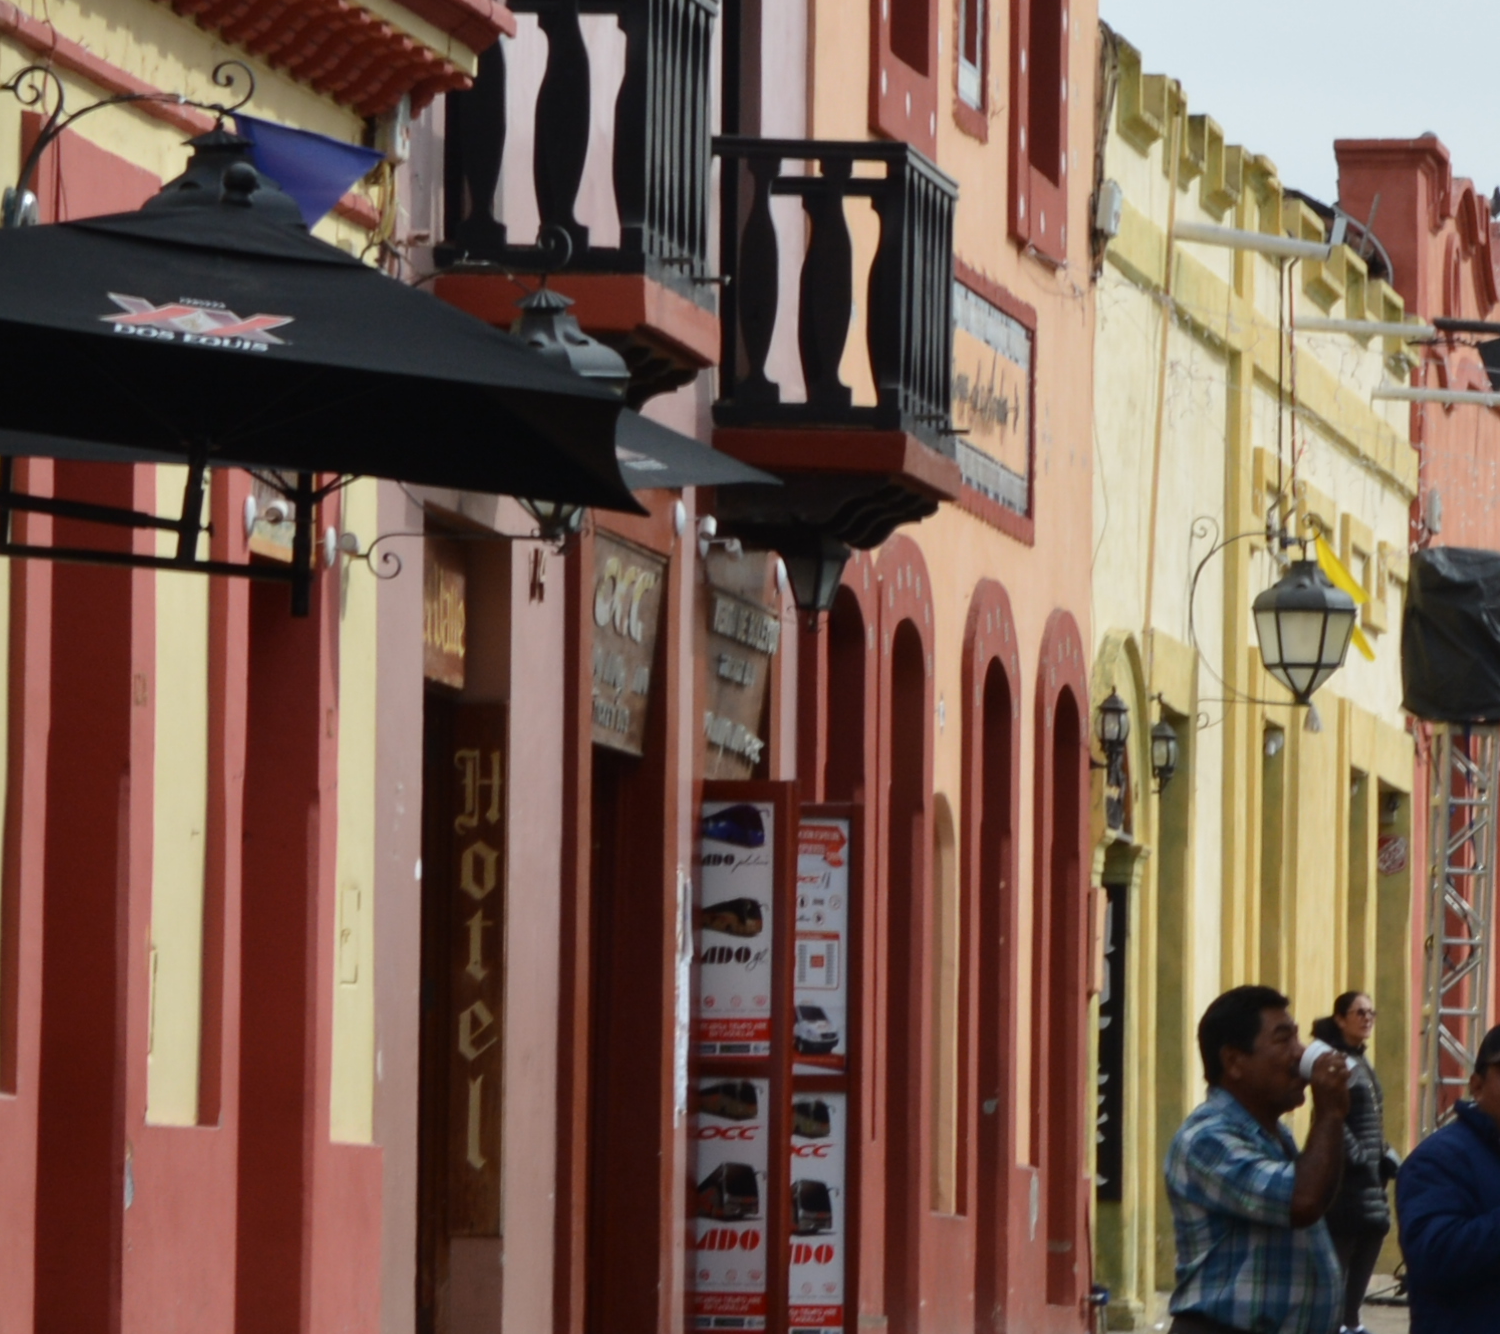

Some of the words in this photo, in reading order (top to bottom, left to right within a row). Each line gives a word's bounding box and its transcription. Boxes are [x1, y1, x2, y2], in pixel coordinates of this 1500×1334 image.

[113, 322, 176, 341] DOS
[182, 332, 269, 353] EQUIS
[454, 749, 501, 1170] Hotel
[700, 946, 751, 964] ADO
[695, 1125, 764, 1140] OCC
[790, 1143, 834, 1158] CC
[695, 1228, 761, 1251] ADO
